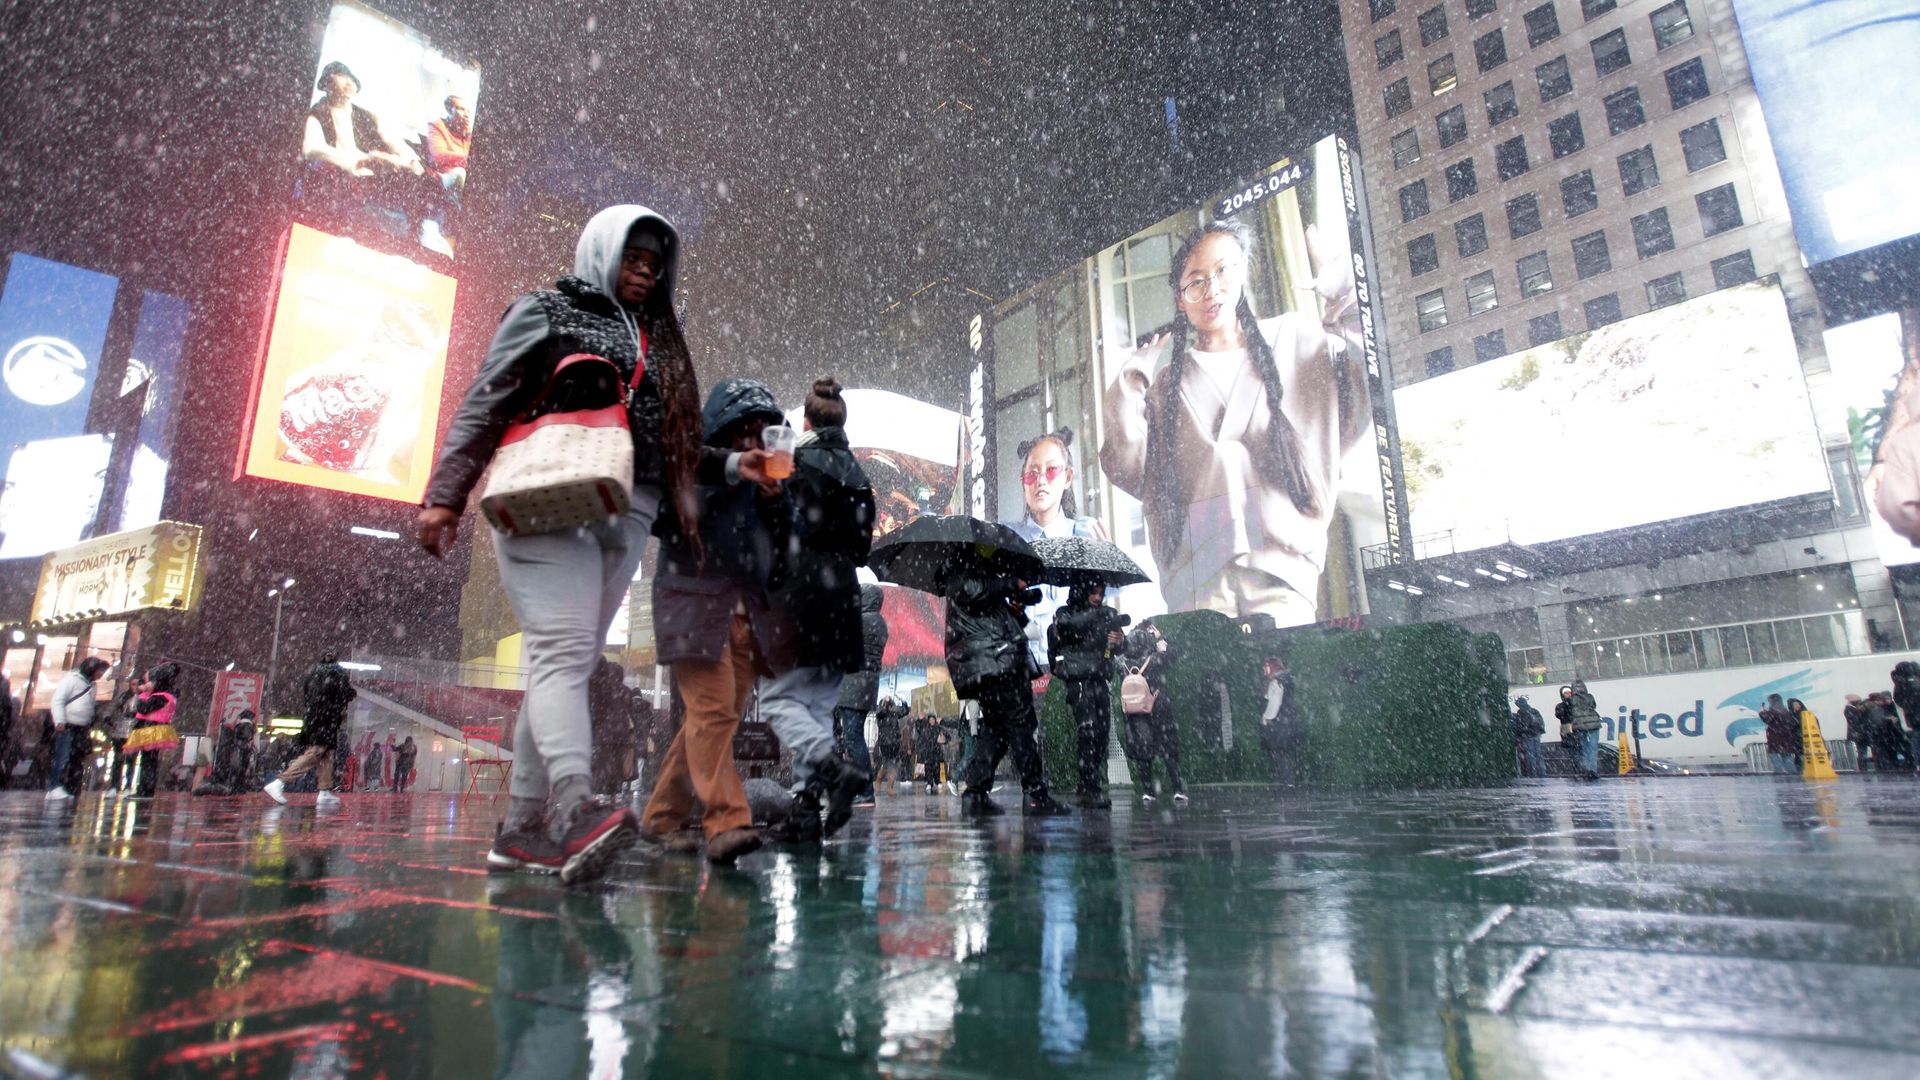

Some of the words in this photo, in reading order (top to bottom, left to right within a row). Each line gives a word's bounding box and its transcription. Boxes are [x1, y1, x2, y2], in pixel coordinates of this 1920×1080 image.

[1222, 165, 1301, 214] 2045.044
[1340, 150, 1356, 212] SCREEN
[1353, 253, 1365, 278] GO
[1357, 281, 1369, 303] TO
[970, 361, 986, 479] SQUARE
[1376, 424, 1388, 450] BE
[54, 553, 111, 577] MISSIONARY
[114, 544, 147, 565] STYLE
[222, 678, 256, 724] tkts
[1600, 700, 1704, 741] nited
